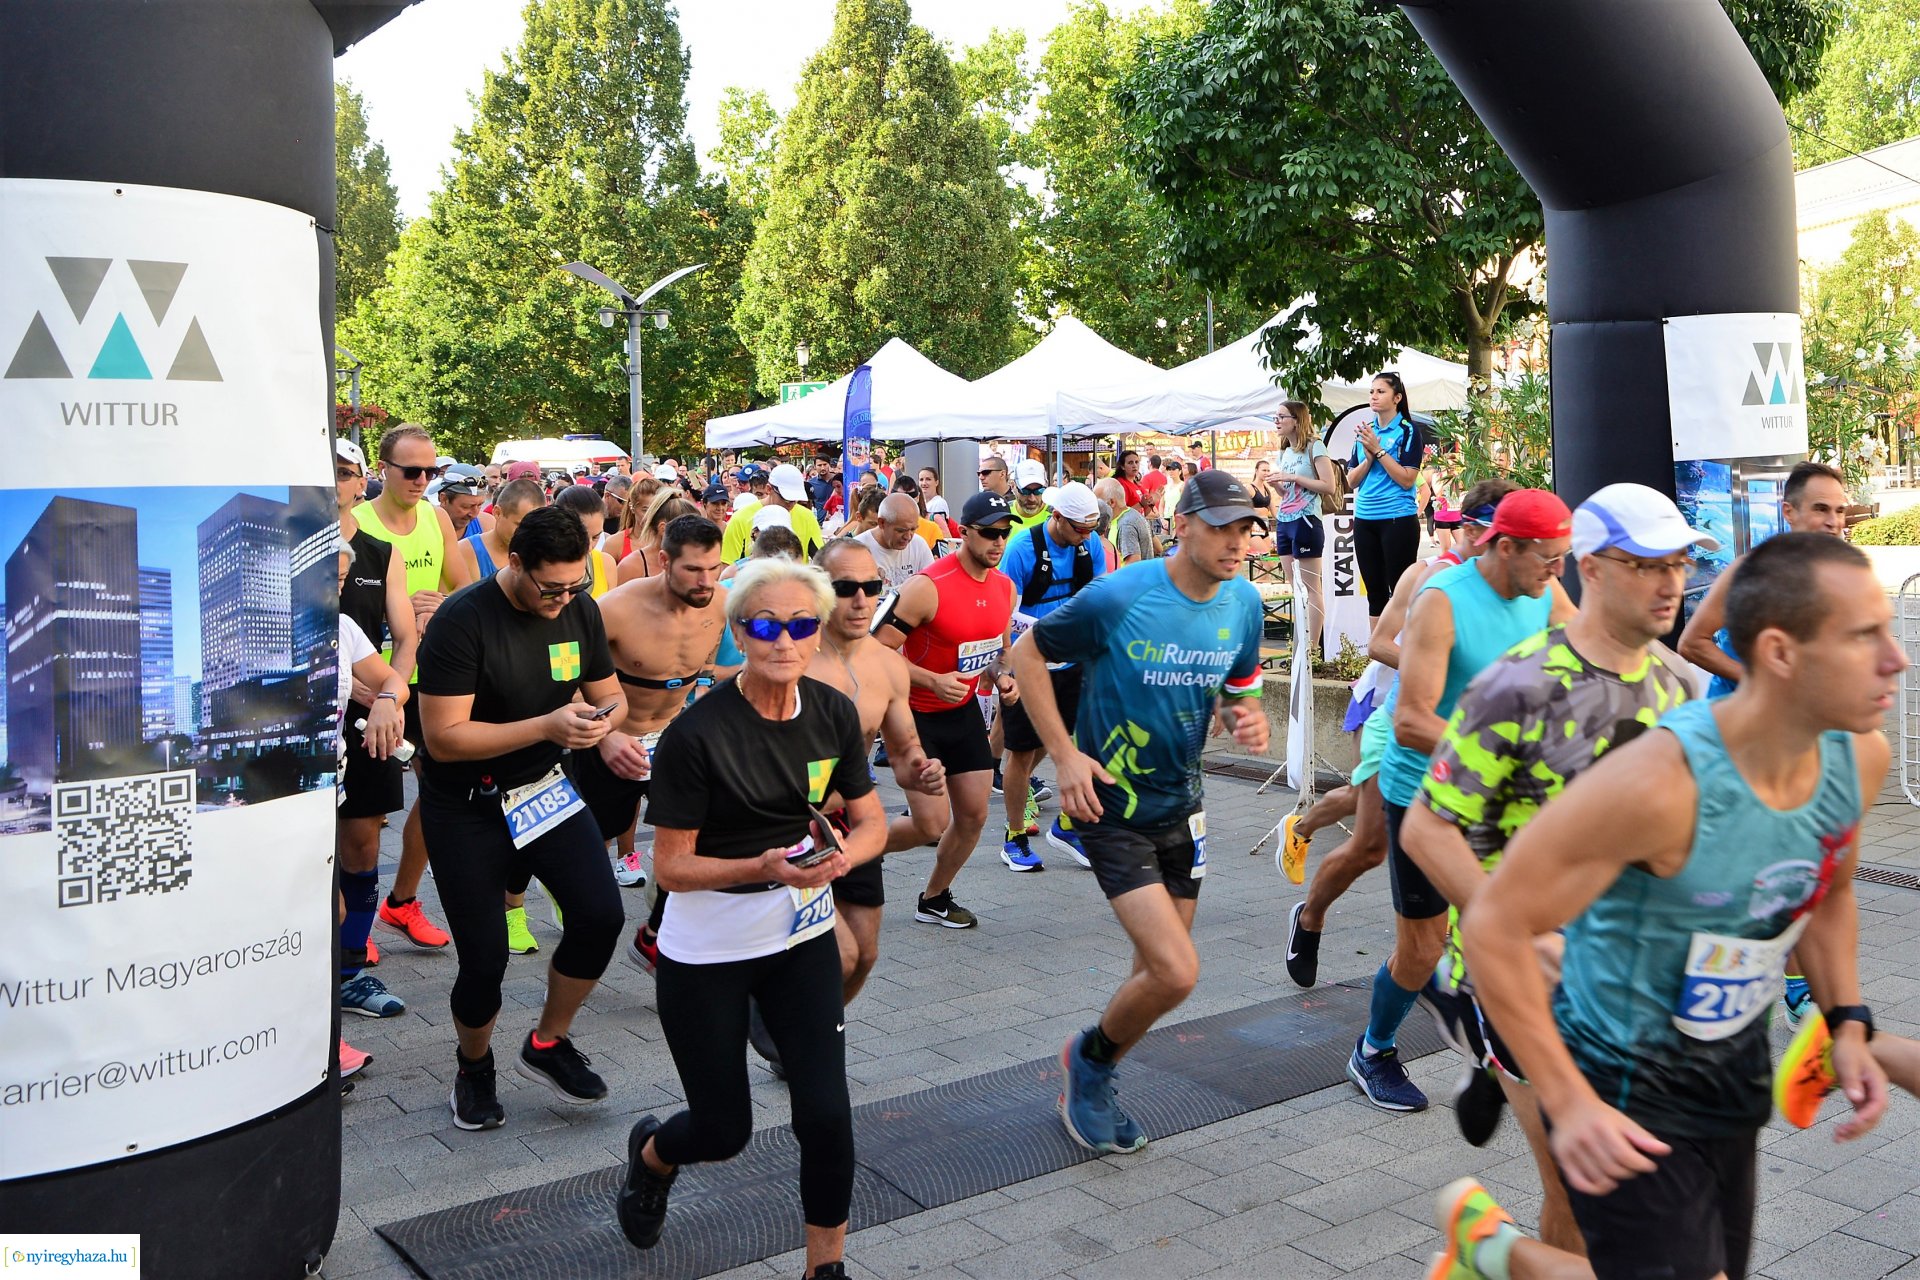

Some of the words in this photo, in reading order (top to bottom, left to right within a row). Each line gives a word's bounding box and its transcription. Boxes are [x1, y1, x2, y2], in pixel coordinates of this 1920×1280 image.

[60, 401, 179, 427] WITTUR
[1761, 415, 1793, 429] WITTUR
[961, 651, 999, 673] 21143
[1143, 669, 1225, 688] HUNGARY
[512, 784, 571, 834] 21185
[106, 928, 303, 994] Magyarország
[0, 1026, 278, 1106] arrier@wittur.com
